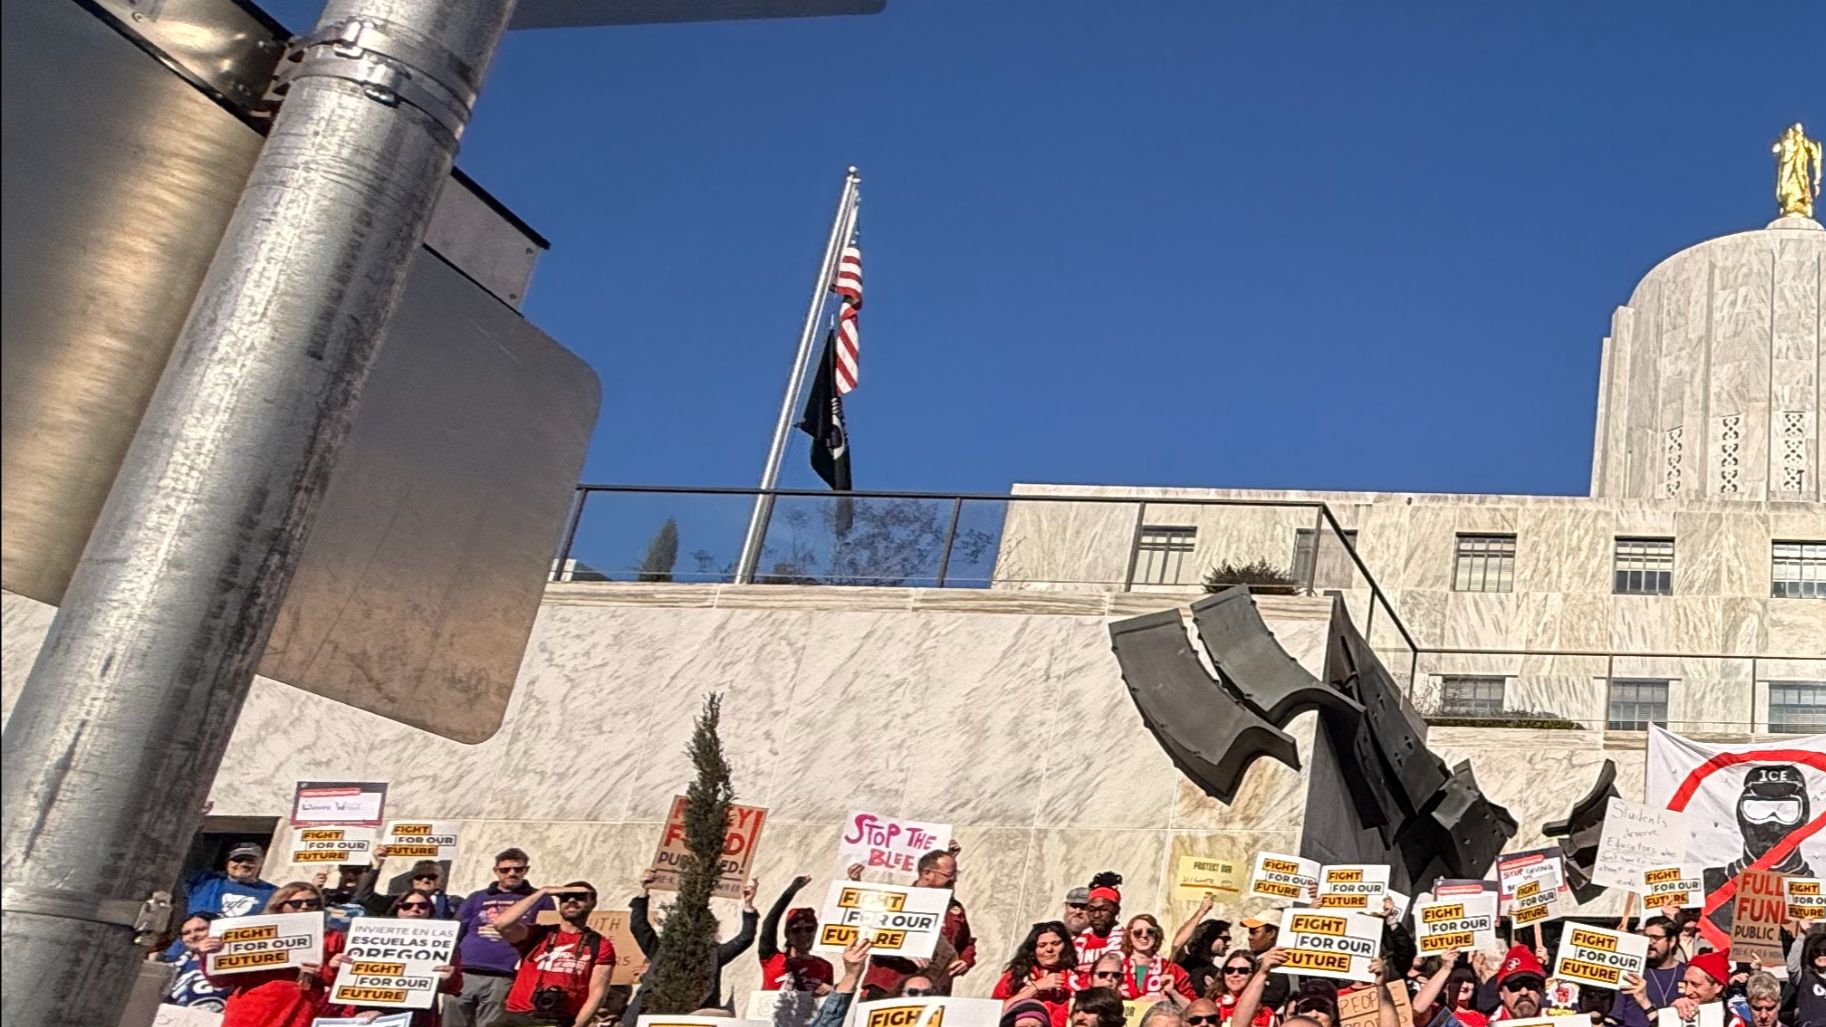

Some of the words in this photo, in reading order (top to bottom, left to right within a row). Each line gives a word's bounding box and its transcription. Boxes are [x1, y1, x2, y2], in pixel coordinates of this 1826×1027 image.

[1759, 770, 1789, 782] ICE
[303, 831, 342, 839] FIGHT
[845, 814, 900, 848] STOP
[906, 827, 937, 850] THE
[337, 841, 366, 849] OUR
[296, 851, 345, 860] FUTURE
[355, 926, 409, 936] INVIERTE
[412, 928, 428, 936] EN
[431, 928, 454, 938] LAS
[352, 936, 428, 948] ESCUELAS
[432, 939, 451, 948] DE
[1572, 932, 1616, 948] FIGHT
[1578, 950, 1608, 961] FOR
[1611, 956, 1638, 969] OUR
[1563, 961, 1618, 982] FUTURE
